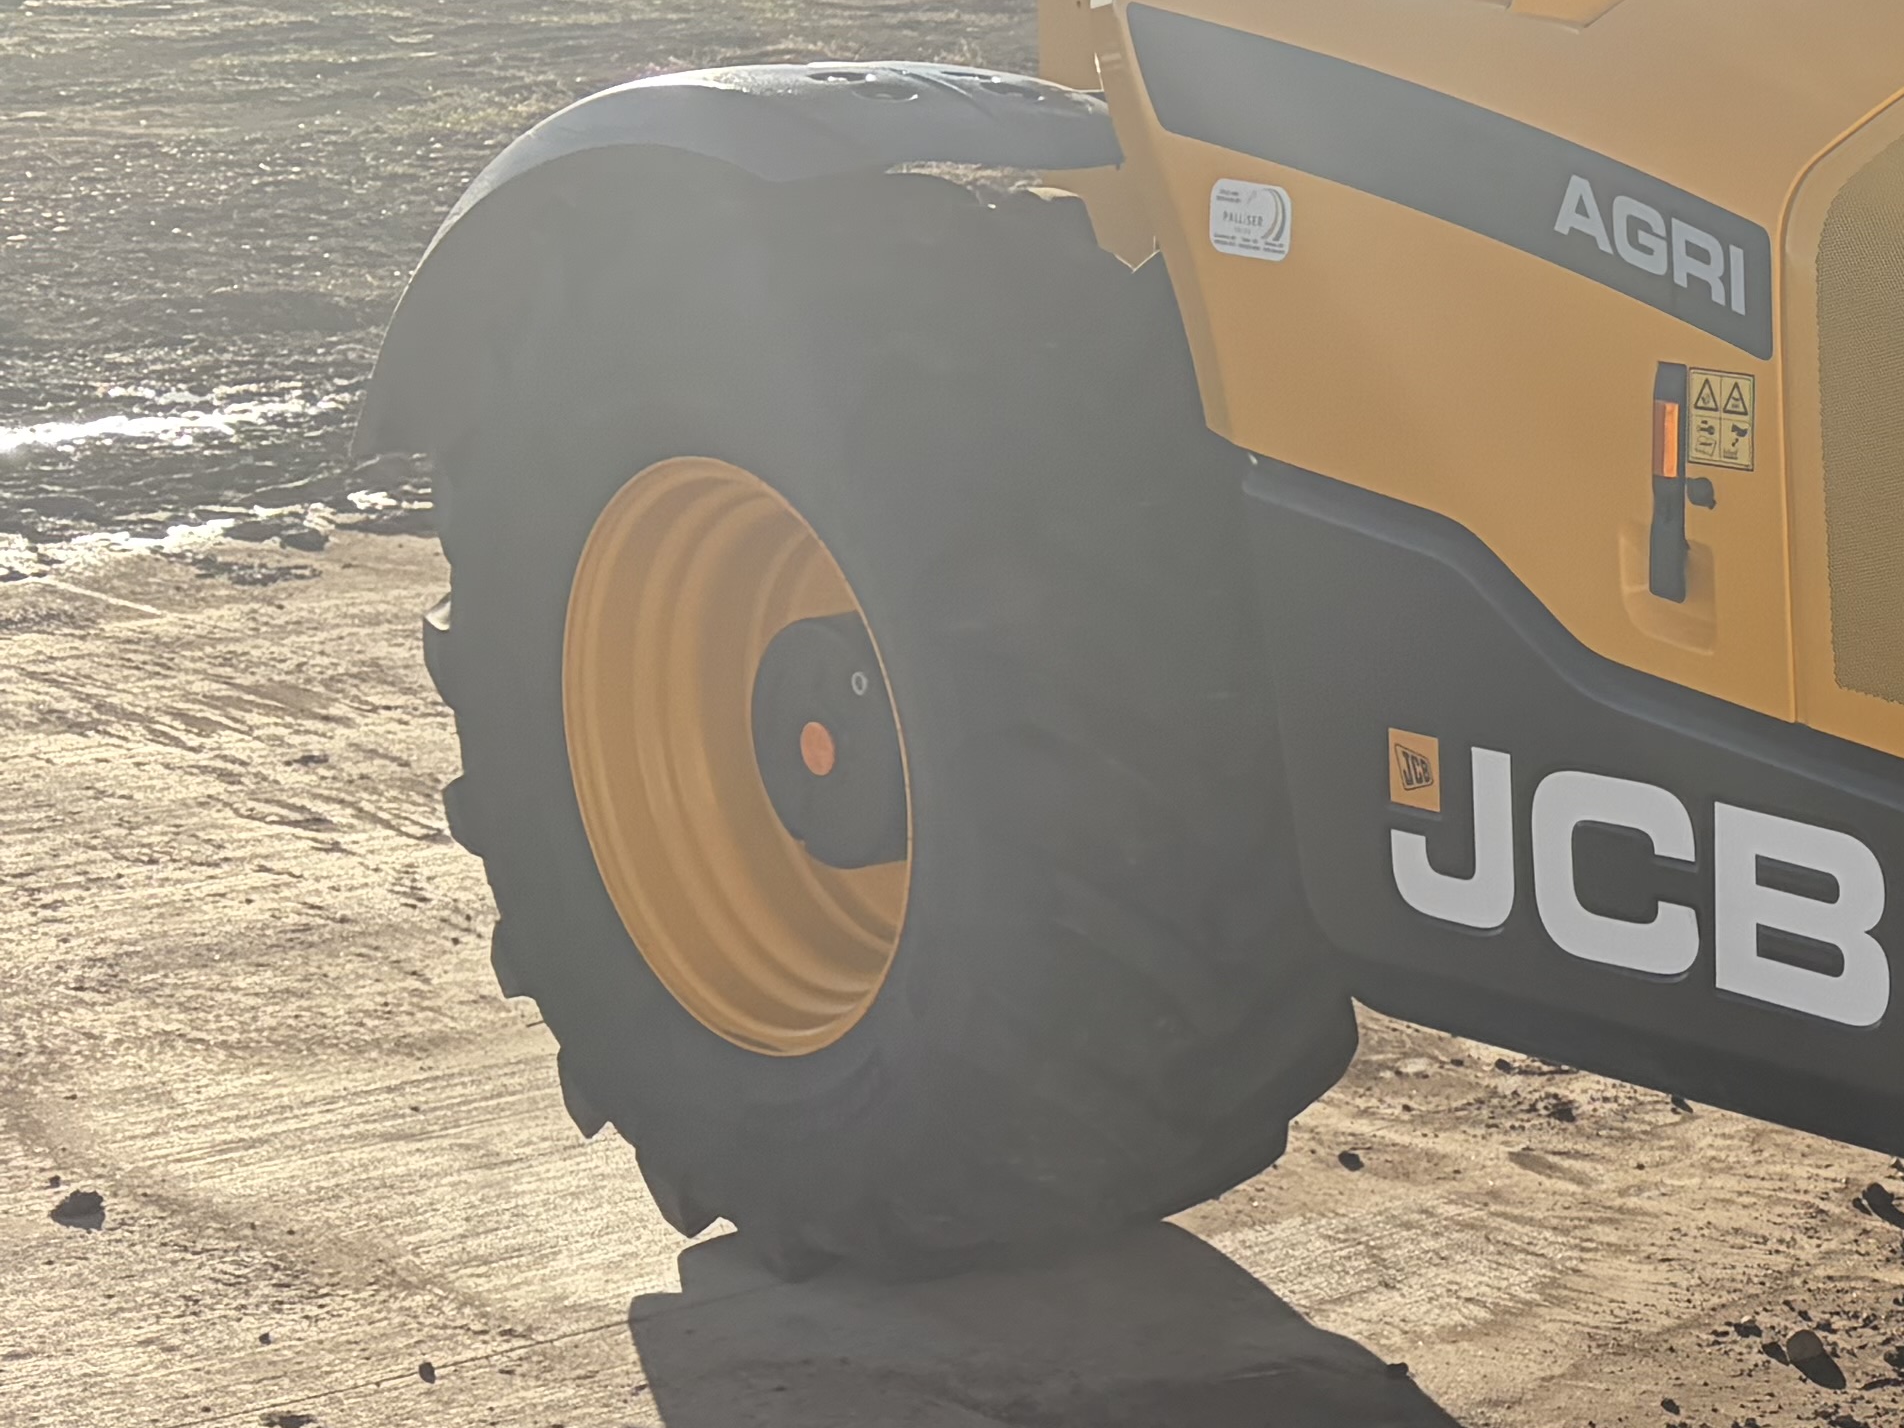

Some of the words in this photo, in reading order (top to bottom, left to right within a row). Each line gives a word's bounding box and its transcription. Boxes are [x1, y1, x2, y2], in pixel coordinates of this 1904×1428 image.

[1554, 174, 1746, 316] AGRI
[1402, 750, 1433, 786] JCB
[1390, 746, 1891, 1027] JCB
